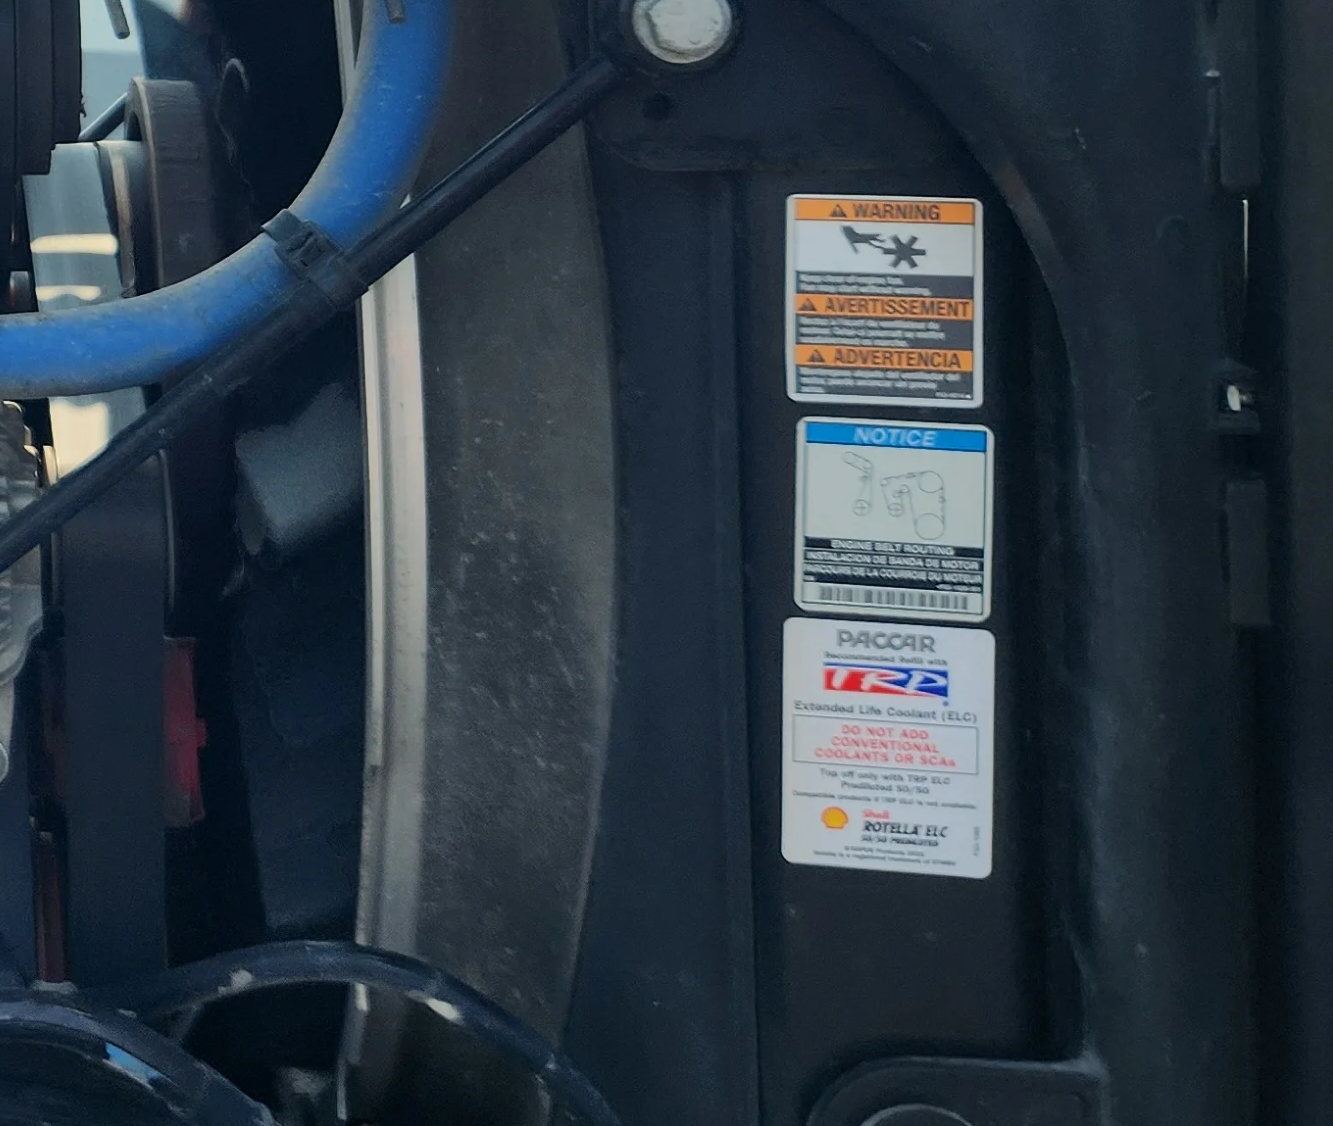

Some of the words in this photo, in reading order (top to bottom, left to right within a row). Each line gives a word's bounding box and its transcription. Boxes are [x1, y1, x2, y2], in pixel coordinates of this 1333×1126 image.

[853, 203, 941, 221] WARNING
[825, 298, 969, 317] AVERTISSEMENT
[833, 348, 962, 369] ADVERTENCIA
[853, 427, 936, 447] NOTICE
[831, 539, 873, 551] ENGINE
[875, 542, 902, 553] BELT
[903, 544, 955, 556] ROUTING
[807, 551, 871, 564] INSTALACION
[873, 555, 887, 565] DE
[941, 560, 979, 571] MOTOR
[837, 629, 936, 653] PACCAR
[824, 651, 895, 663] Recommended
[827, 668, 948, 697] TRP
[794, 700, 854, 714] Extended
[858, 705, 882, 716] Life
[887, 706, 937, 720] Coolant
[941, 711, 978, 724] (ELC)
[841, 725, 861, 735] DO
[867, 727, 893, 738] NOT
[901, 729, 929, 740] ADD
[831, 736, 940, 754] CONVENTIONAL
[814, 747, 888, 763] COOLANTS
[894, 752, 914, 764] OR
[908, 774, 927, 783] TRP
[931, 776, 951, 785] ELC
[862, 809, 890, 820] Shell
[926, 825, 949, 839] ELC
